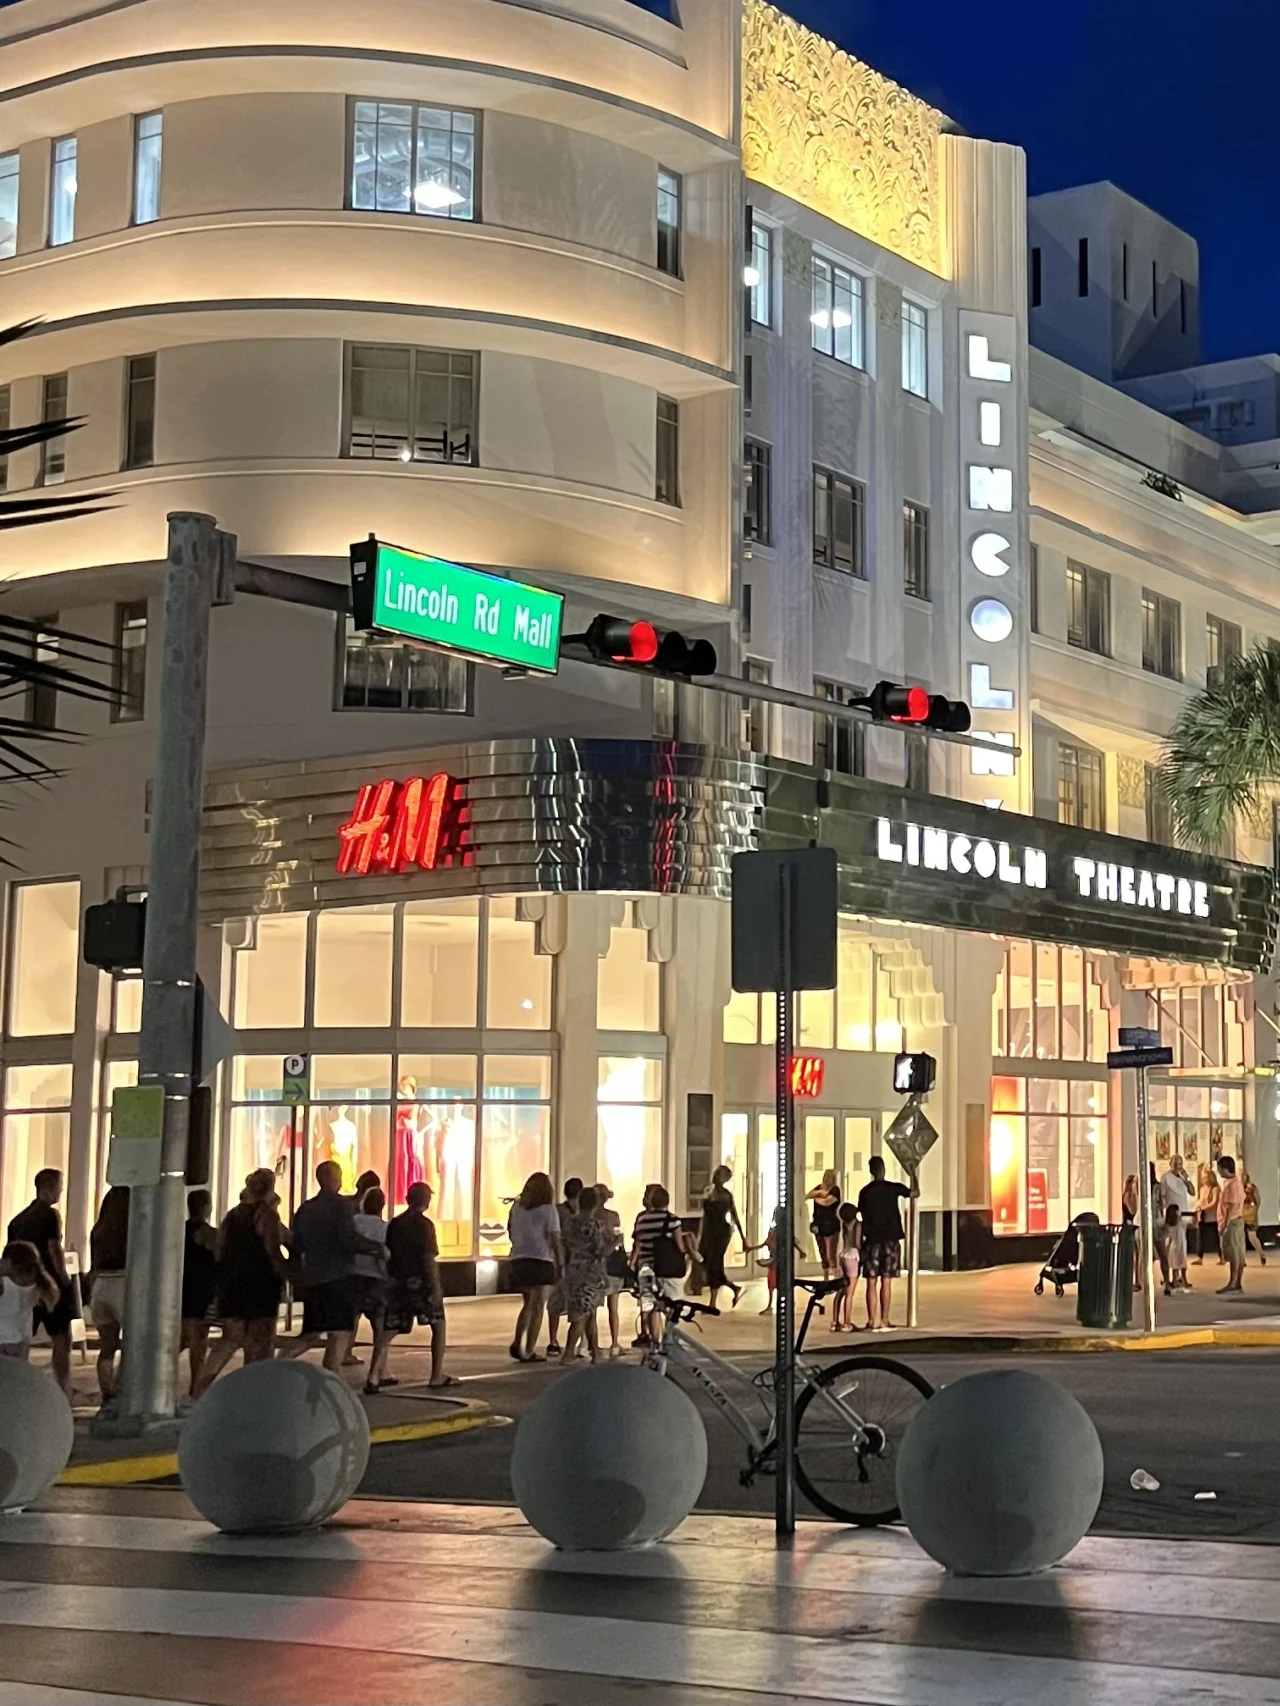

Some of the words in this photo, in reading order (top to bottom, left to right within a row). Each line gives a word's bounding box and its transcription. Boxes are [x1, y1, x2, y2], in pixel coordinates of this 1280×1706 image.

[967, 333, 1014, 776] LINCOLN
[384, 568, 458, 626] Lincoln
[474, 593, 500, 636] Rd
[513, 605, 552, 650] Mall
[336, 772, 450, 874] H&M
[877, 817, 1047, 889] LINCOLN
[1073, 856, 1210, 918] THEATRE
